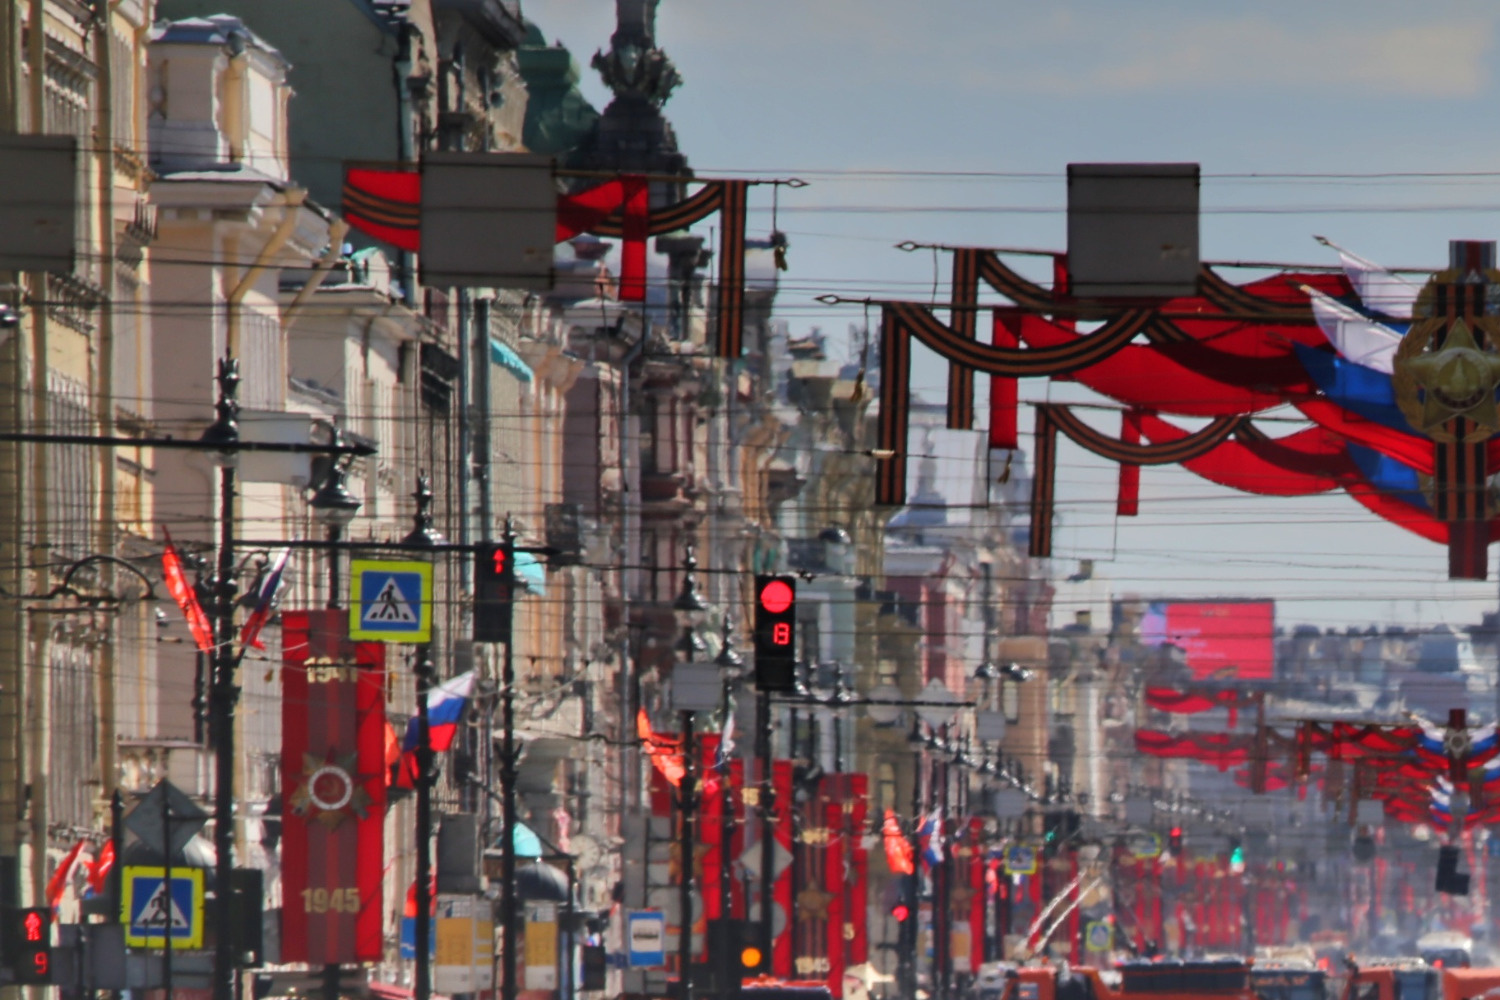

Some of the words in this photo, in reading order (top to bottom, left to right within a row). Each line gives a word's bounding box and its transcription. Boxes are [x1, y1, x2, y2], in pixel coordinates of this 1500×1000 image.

[773, 622, 790, 645] 13
[300, 887, 361, 913] 1945
[34, 951, 48, 974] 9
